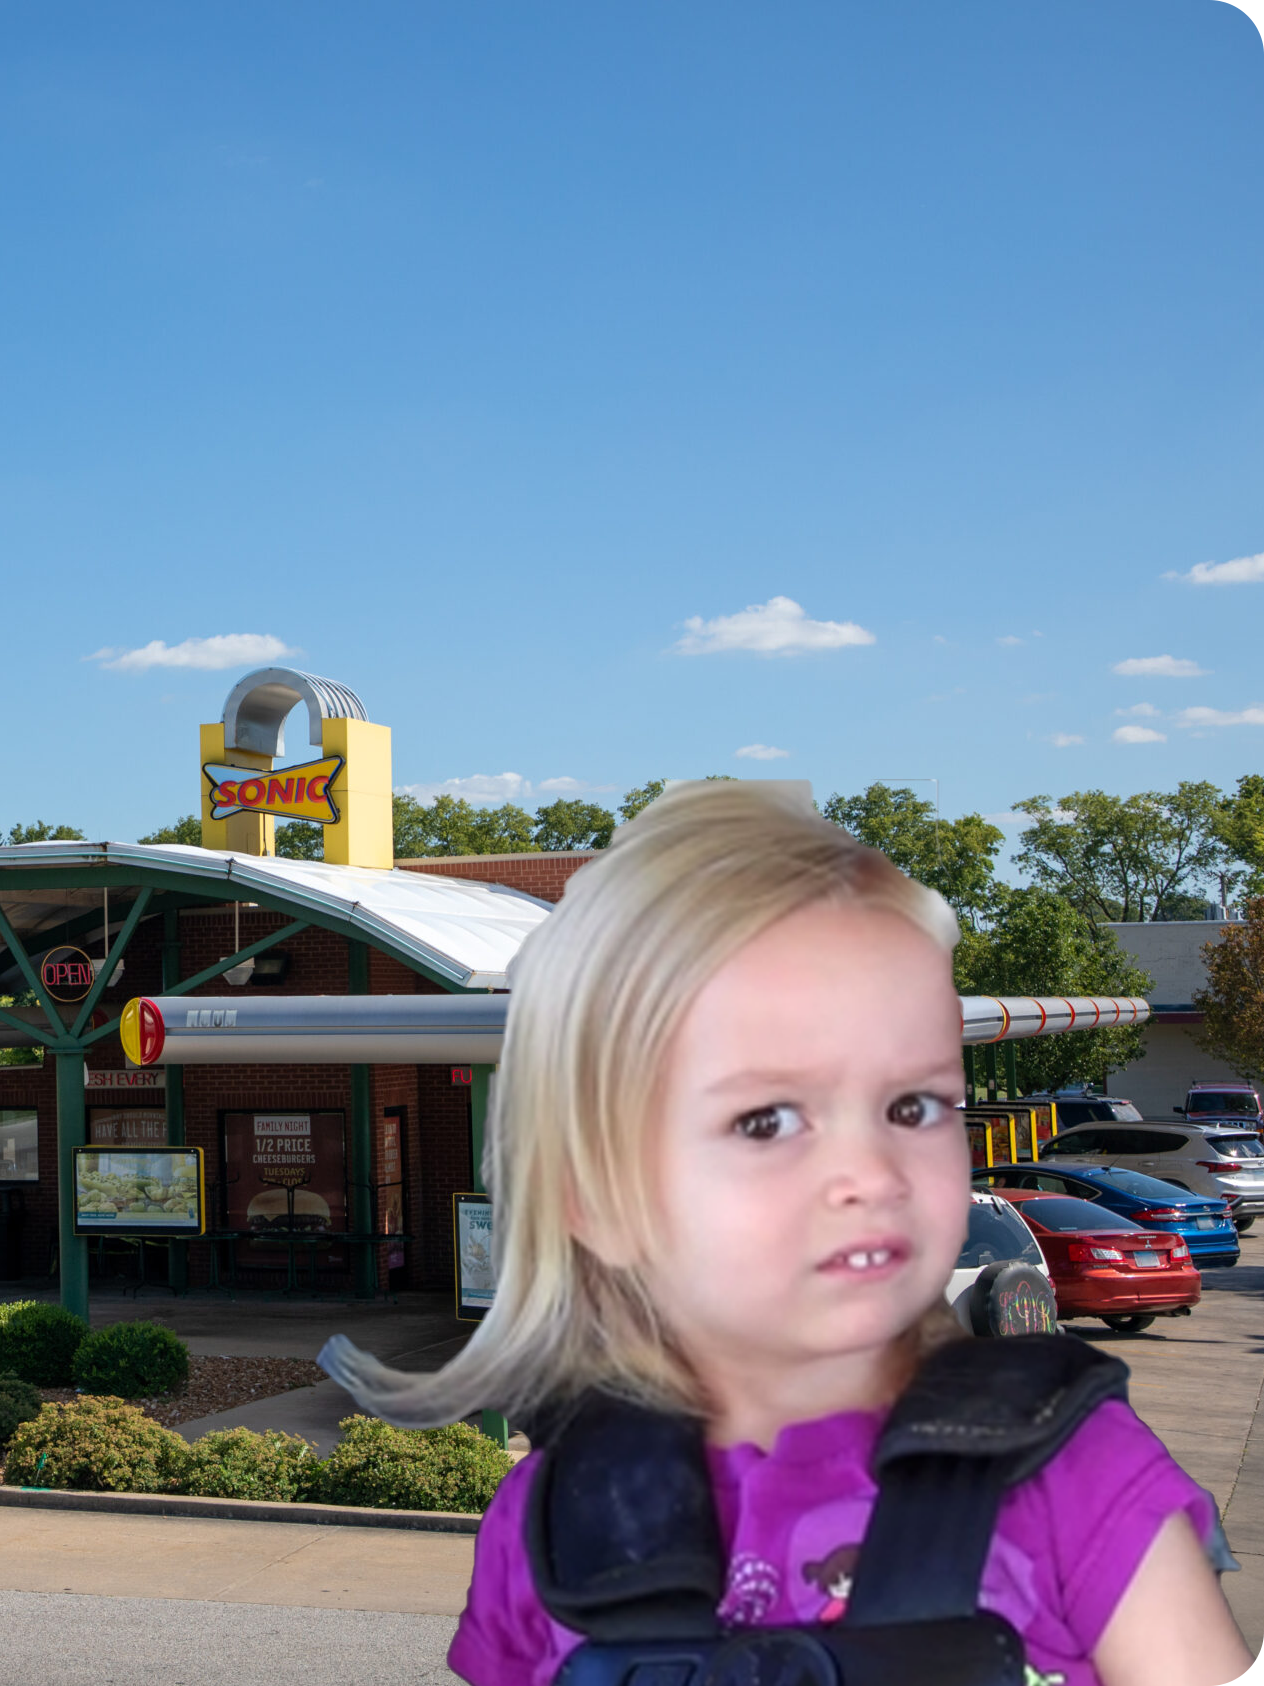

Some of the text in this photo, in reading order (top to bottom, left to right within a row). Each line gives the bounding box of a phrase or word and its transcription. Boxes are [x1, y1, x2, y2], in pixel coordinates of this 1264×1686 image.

[215, 775, 330, 808] SONIC
[43, 963, 91, 985] OPEN
[88, 1071, 158, 1086] ESH EVERY
[452, 1068, 473, 1084] FU
[96, 1122, 118, 1138] HAVE
[121, 1121, 139, 1138] ALL
[141, 1121, 160, 1138] THE
[256, 1121, 309, 1132] FAMILY NIGHT
[256, 1138, 312, 1152] 1/2 PRICE
[253, 1154, 316, 1164] CHEESEBURGERS
[264, 1167, 306, 1176] TUESDAYS
[469, 1221, 493, 1231] SWE
